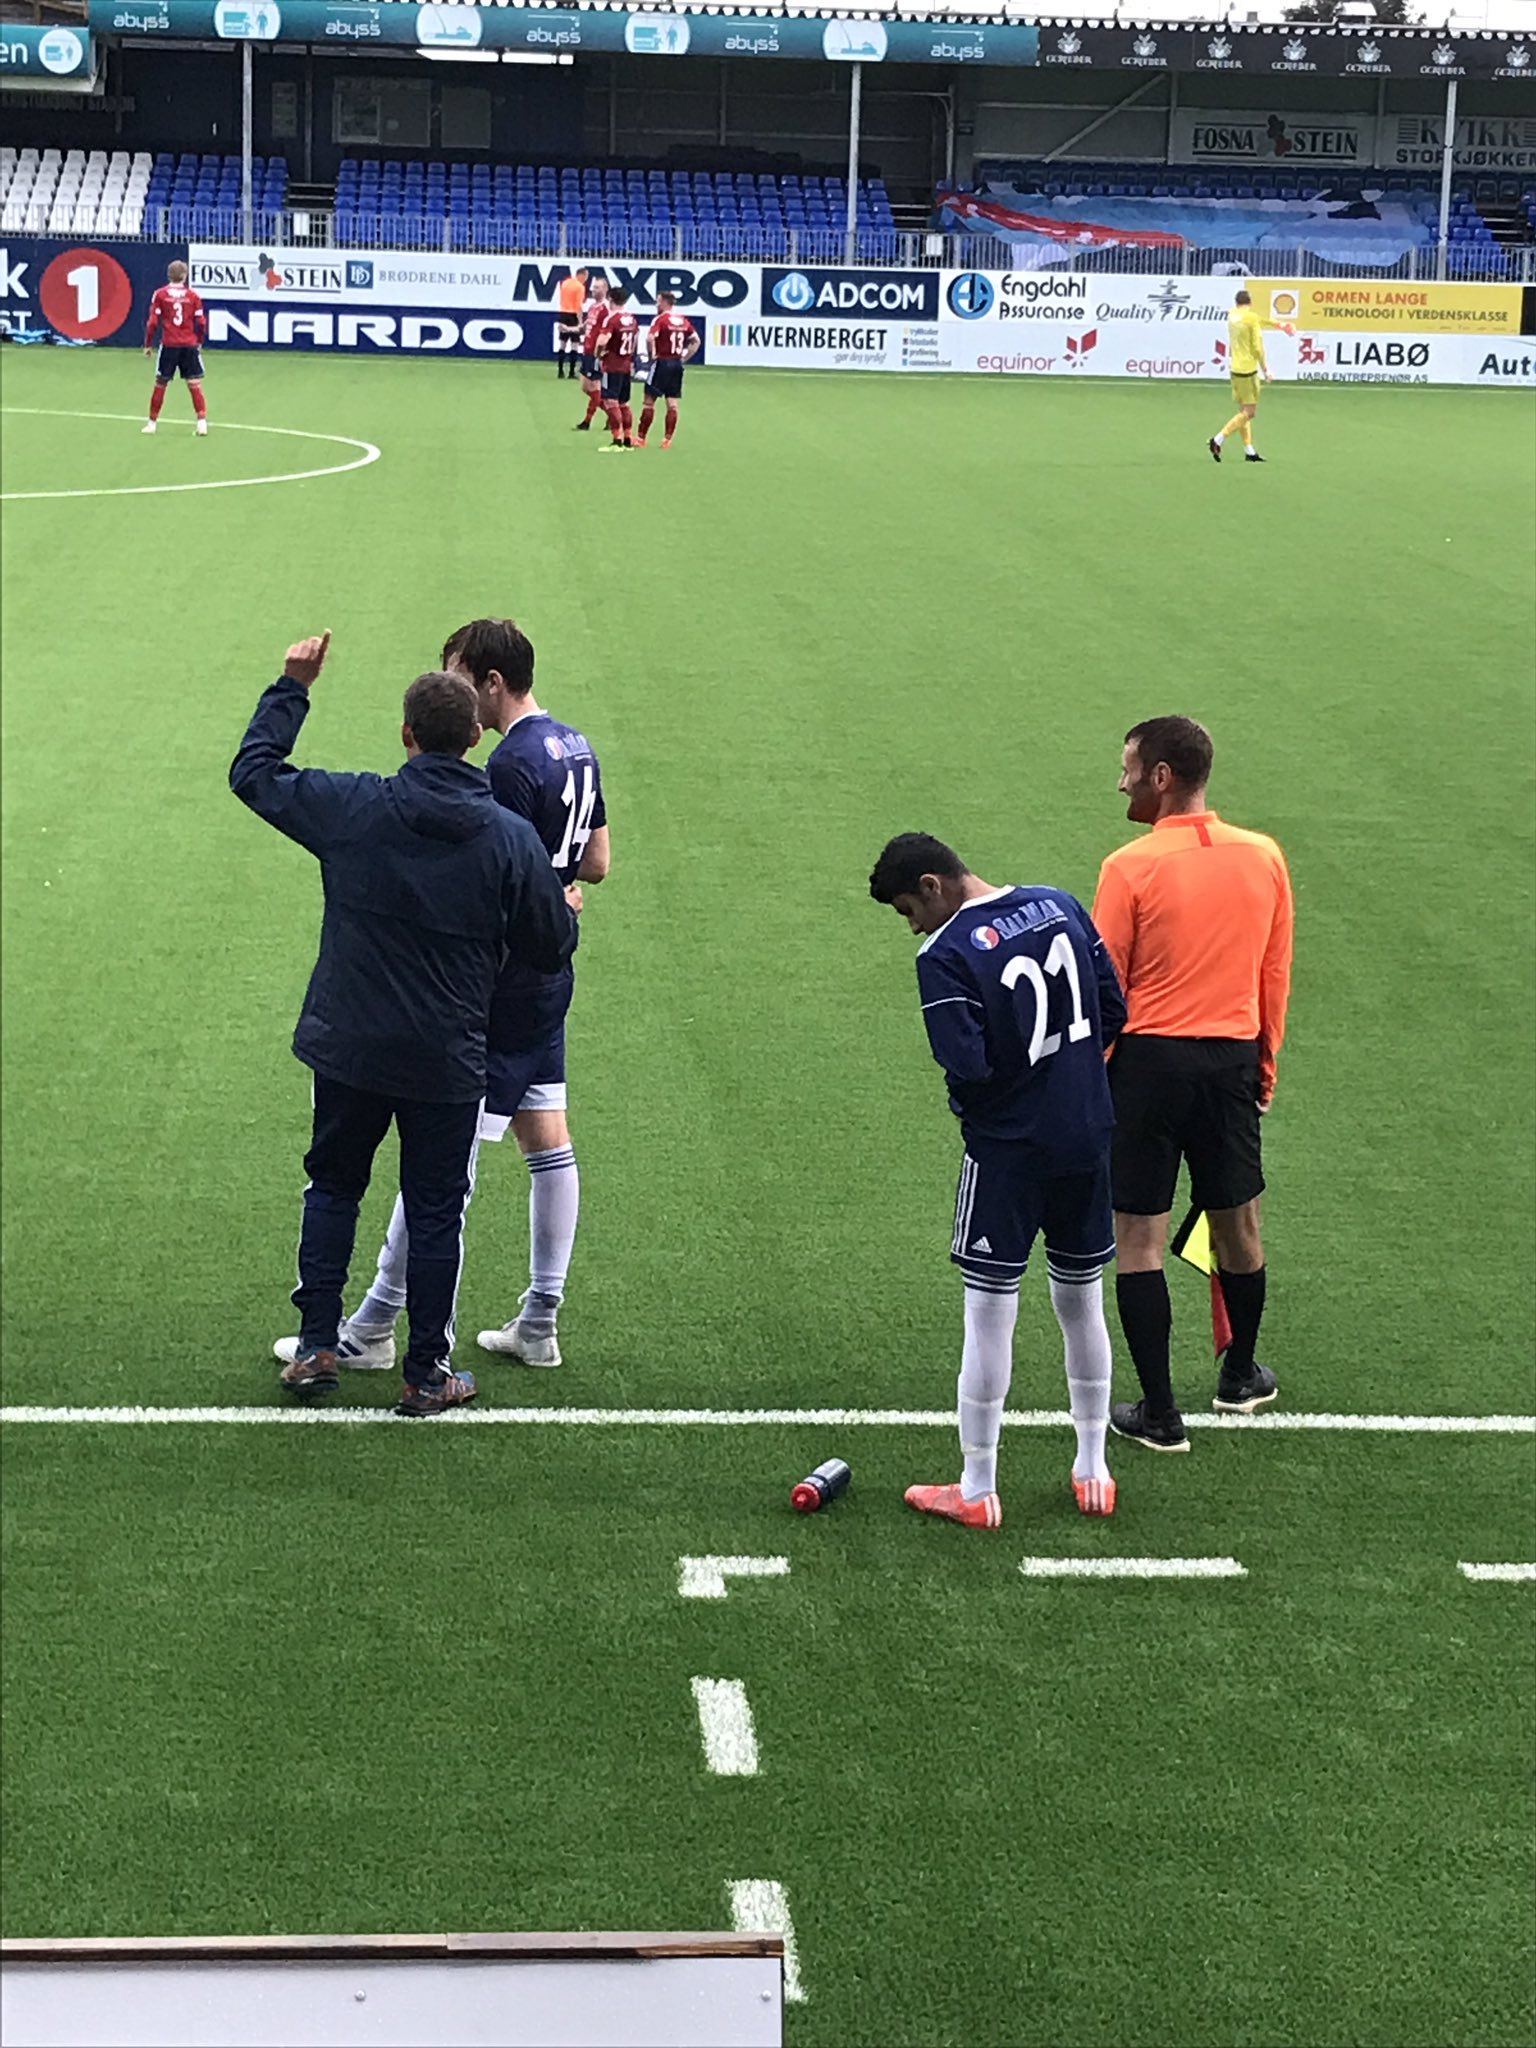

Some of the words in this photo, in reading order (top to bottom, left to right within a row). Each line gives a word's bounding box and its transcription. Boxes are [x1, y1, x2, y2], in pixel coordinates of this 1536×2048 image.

[113, 12, 169, 31] abyss
[325, 19, 381, 38] abyss
[527, 26, 581, 46] abyss
[725, 34, 779, 54] abyss
[931, 41, 984, 60] abyss
[1192, 128, 1254, 150] FOSNA
[1293, 131, 1358, 153] STEIN
[191, 265, 247, 284] FOSNA
[284, 268, 342, 288] STEIN
[379, 270, 457, 286] BRØDRENE
[461, 272, 501, 286] DAHL
[816, 281, 925, 310] ADCOM
[1001, 274, 1086, 302] Engdahl
[1312, 291, 1370, 304] ORMEN
[1375, 292, 1428, 305] LANGE
[173, 302, 183, 326] 3
[999, 301, 1085, 320] Assuranse
[1095, 303, 1156, 323] Quality
[1175, 305, 1229, 321] Drillin
[1323, 307, 1395, 320] TEKNOLOGI
[1407, 309, 1508, 322] VERDENSKLASSE
[208, 309, 524, 351] NARDO
[747, 325, 887, 350] KVERNBERGET
[669, 331, 685, 354] 13
[976, 353, 1056, 373] equinor
[1336, 342, 1430, 367] LIABØ
[1478, 353, 1536, 376] Aut
[1125, 357, 1205, 377] equinor
[1413, 374, 1428, 384] AS
[551, 765, 597, 868] 14
[1000, 932, 1092, 1067] 21
